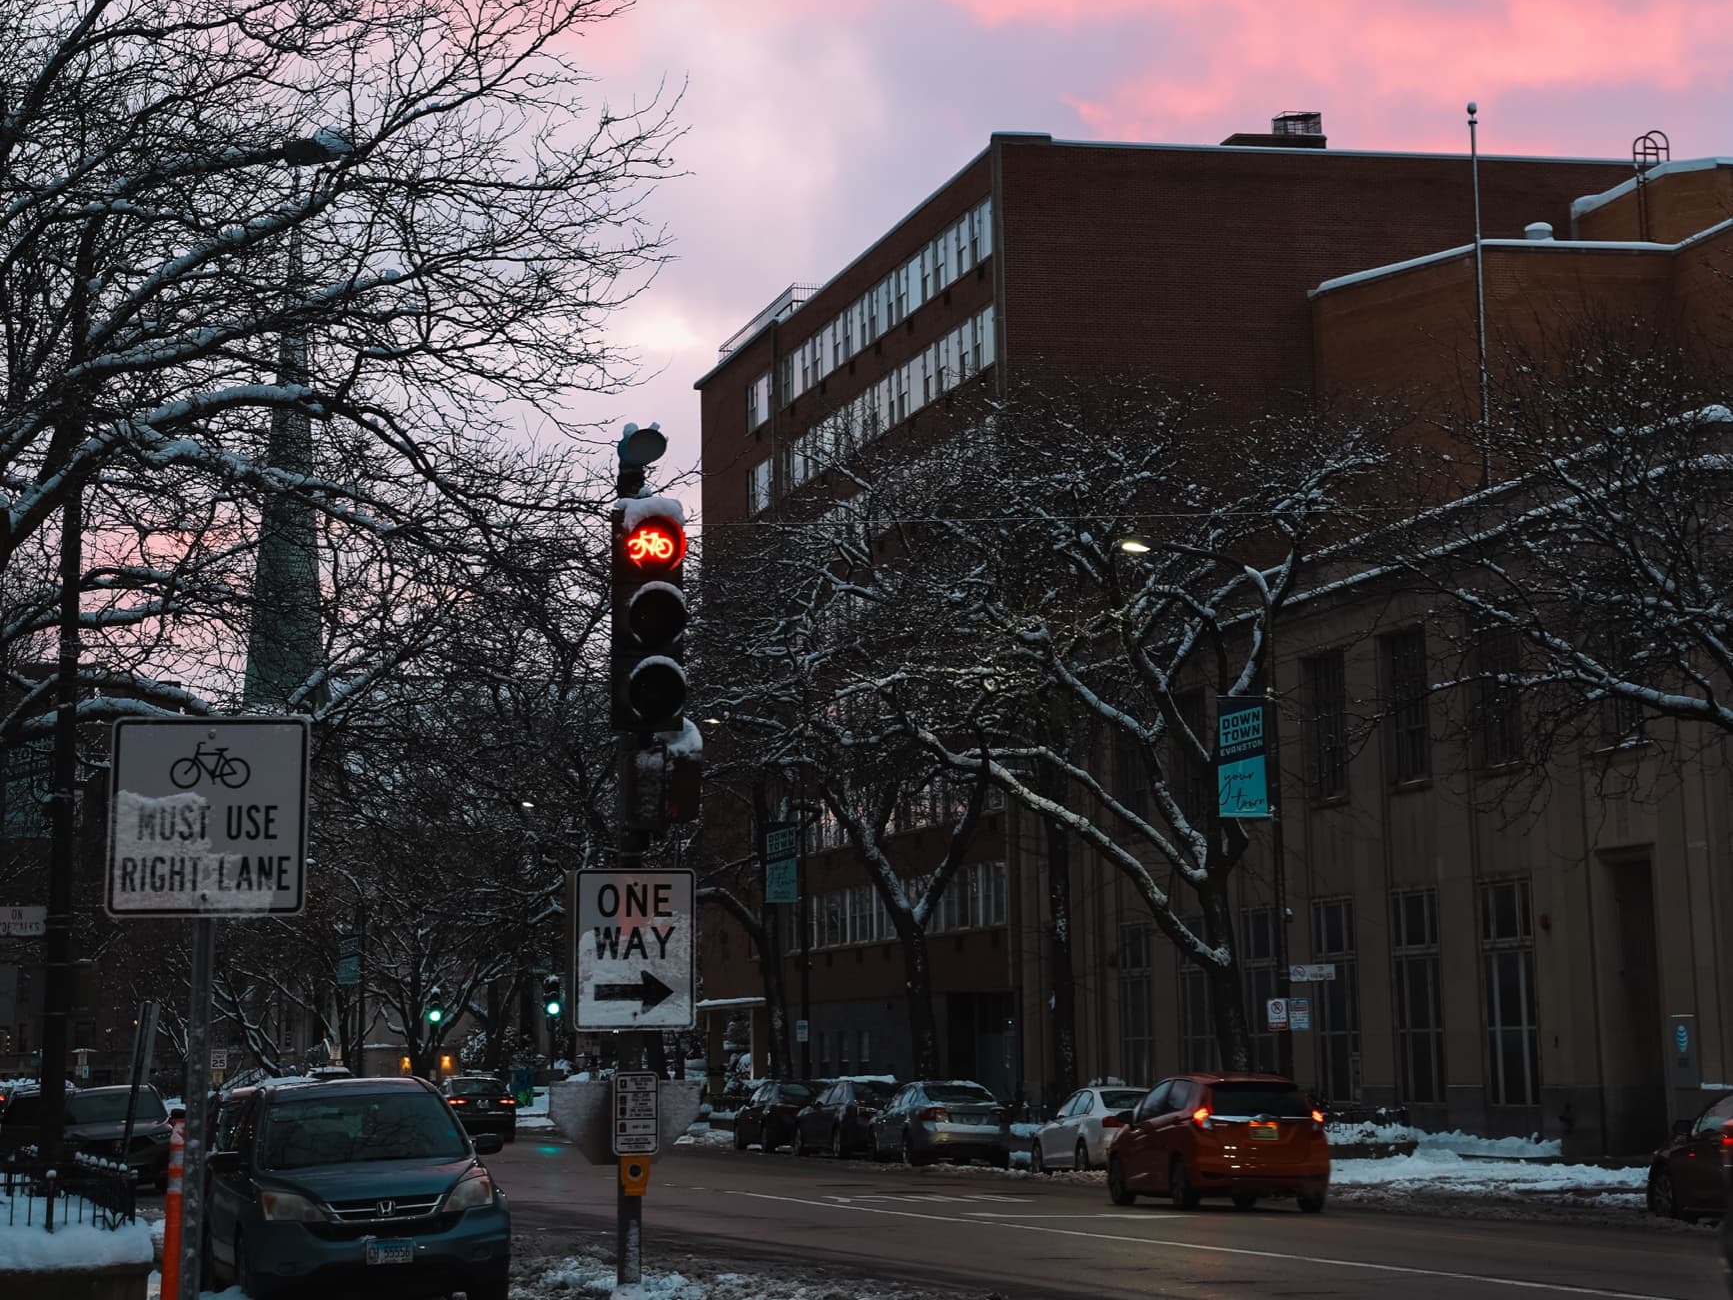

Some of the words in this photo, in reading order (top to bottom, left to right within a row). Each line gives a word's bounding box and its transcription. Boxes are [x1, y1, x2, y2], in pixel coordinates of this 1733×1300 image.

[1222, 710, 1260, 729] DOWN
[1222, 724, 1260, 743] TOWN
[1220, 739, 1263, 756] EVANSTON
[137, 804, 210, 841] MUST
[226, 804, 278, 841] USE
[121, 856, 204, 893] RIGHT
[218, 856, 291, 892] LANE
[598, 884, 673, 918] ONE
[11, 908, 24, 921] ON
[594, 926, 676, 960] WAY
[212, 1059, 225, 1068] 25
